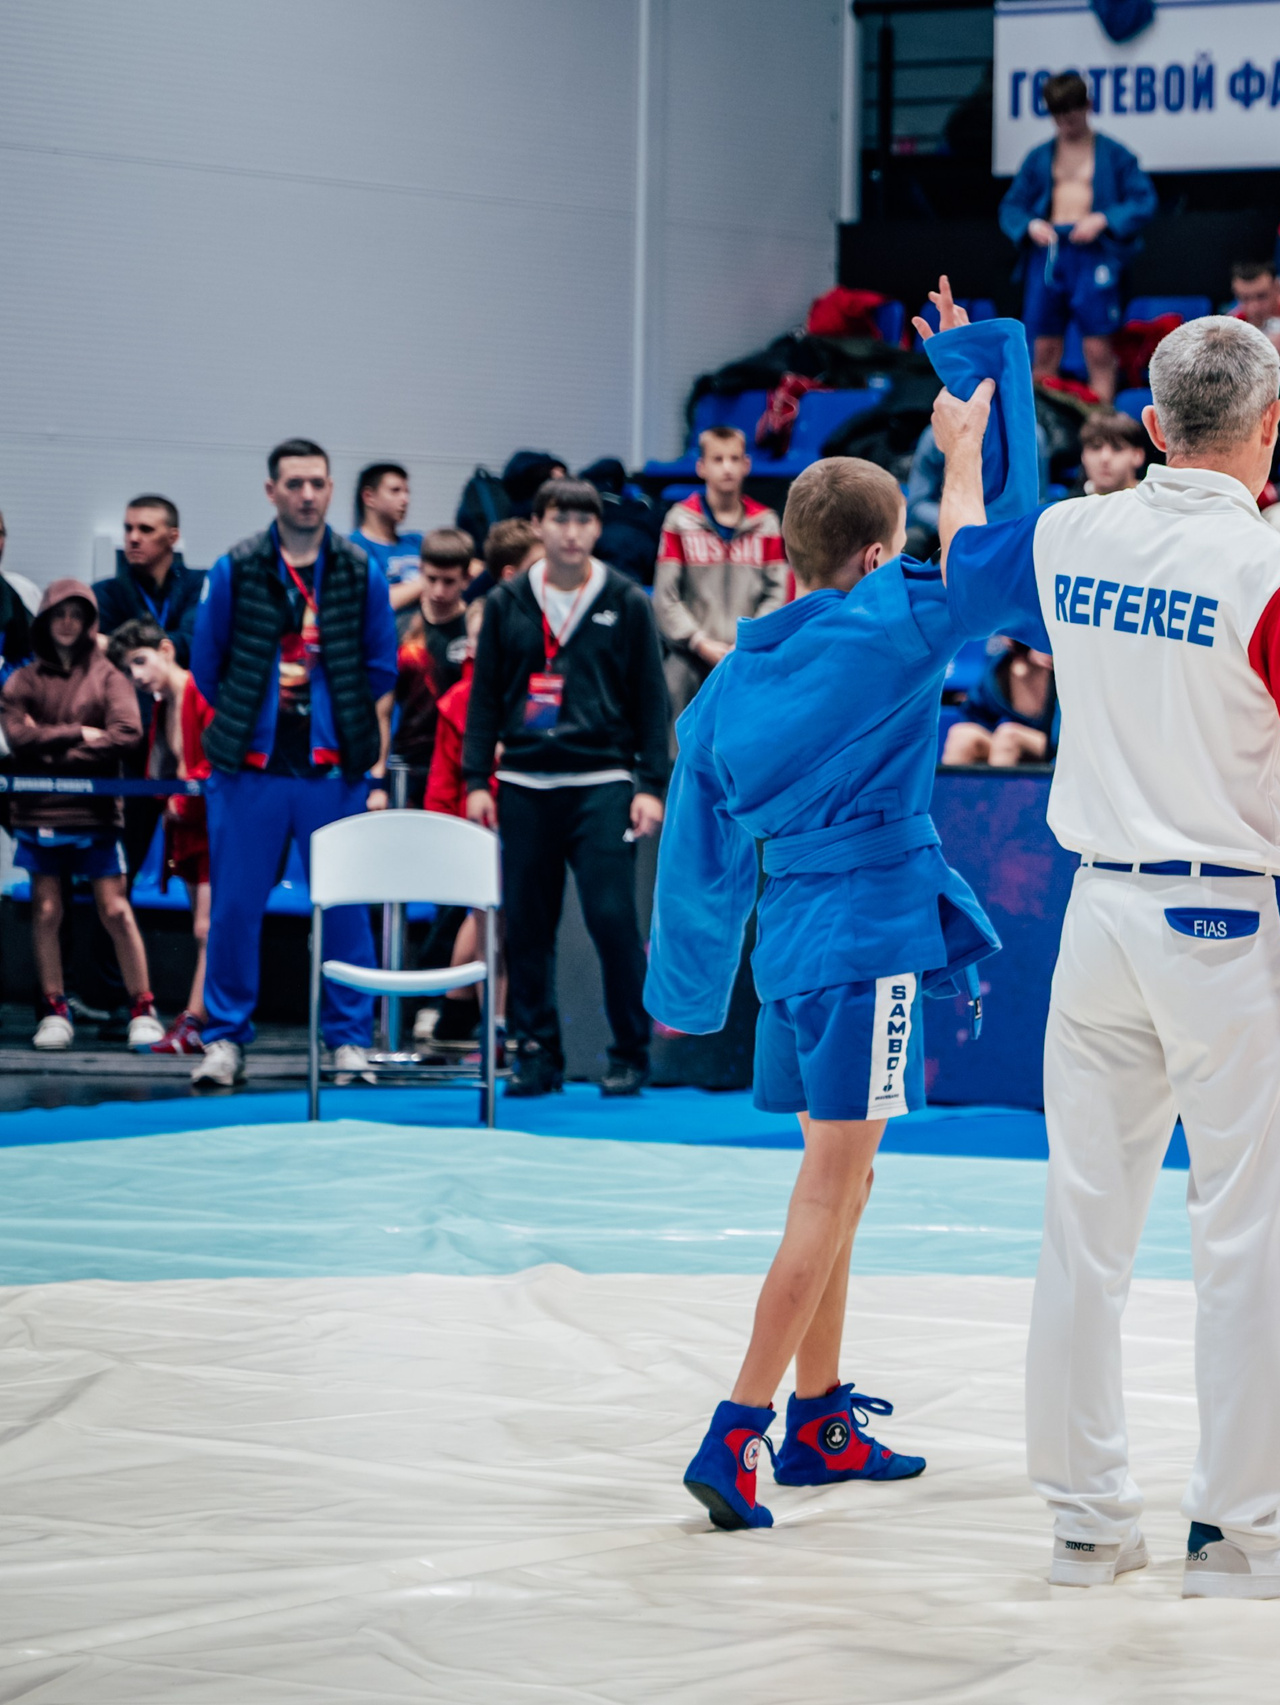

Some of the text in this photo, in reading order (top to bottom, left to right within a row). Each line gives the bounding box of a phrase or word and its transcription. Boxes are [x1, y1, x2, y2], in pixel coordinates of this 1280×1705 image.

[1010, 52, 1214, 119] ГОТЕВОЙ
[1054, 574, 1219, 647] REFEREE
[1193, 920, 1227, 937] FIAS
[887, 985, 907, 1071] SAMBO
[1065, 1540, 1096, 1552] SINCE
[1186, 1551, 1208, 1561] 890
